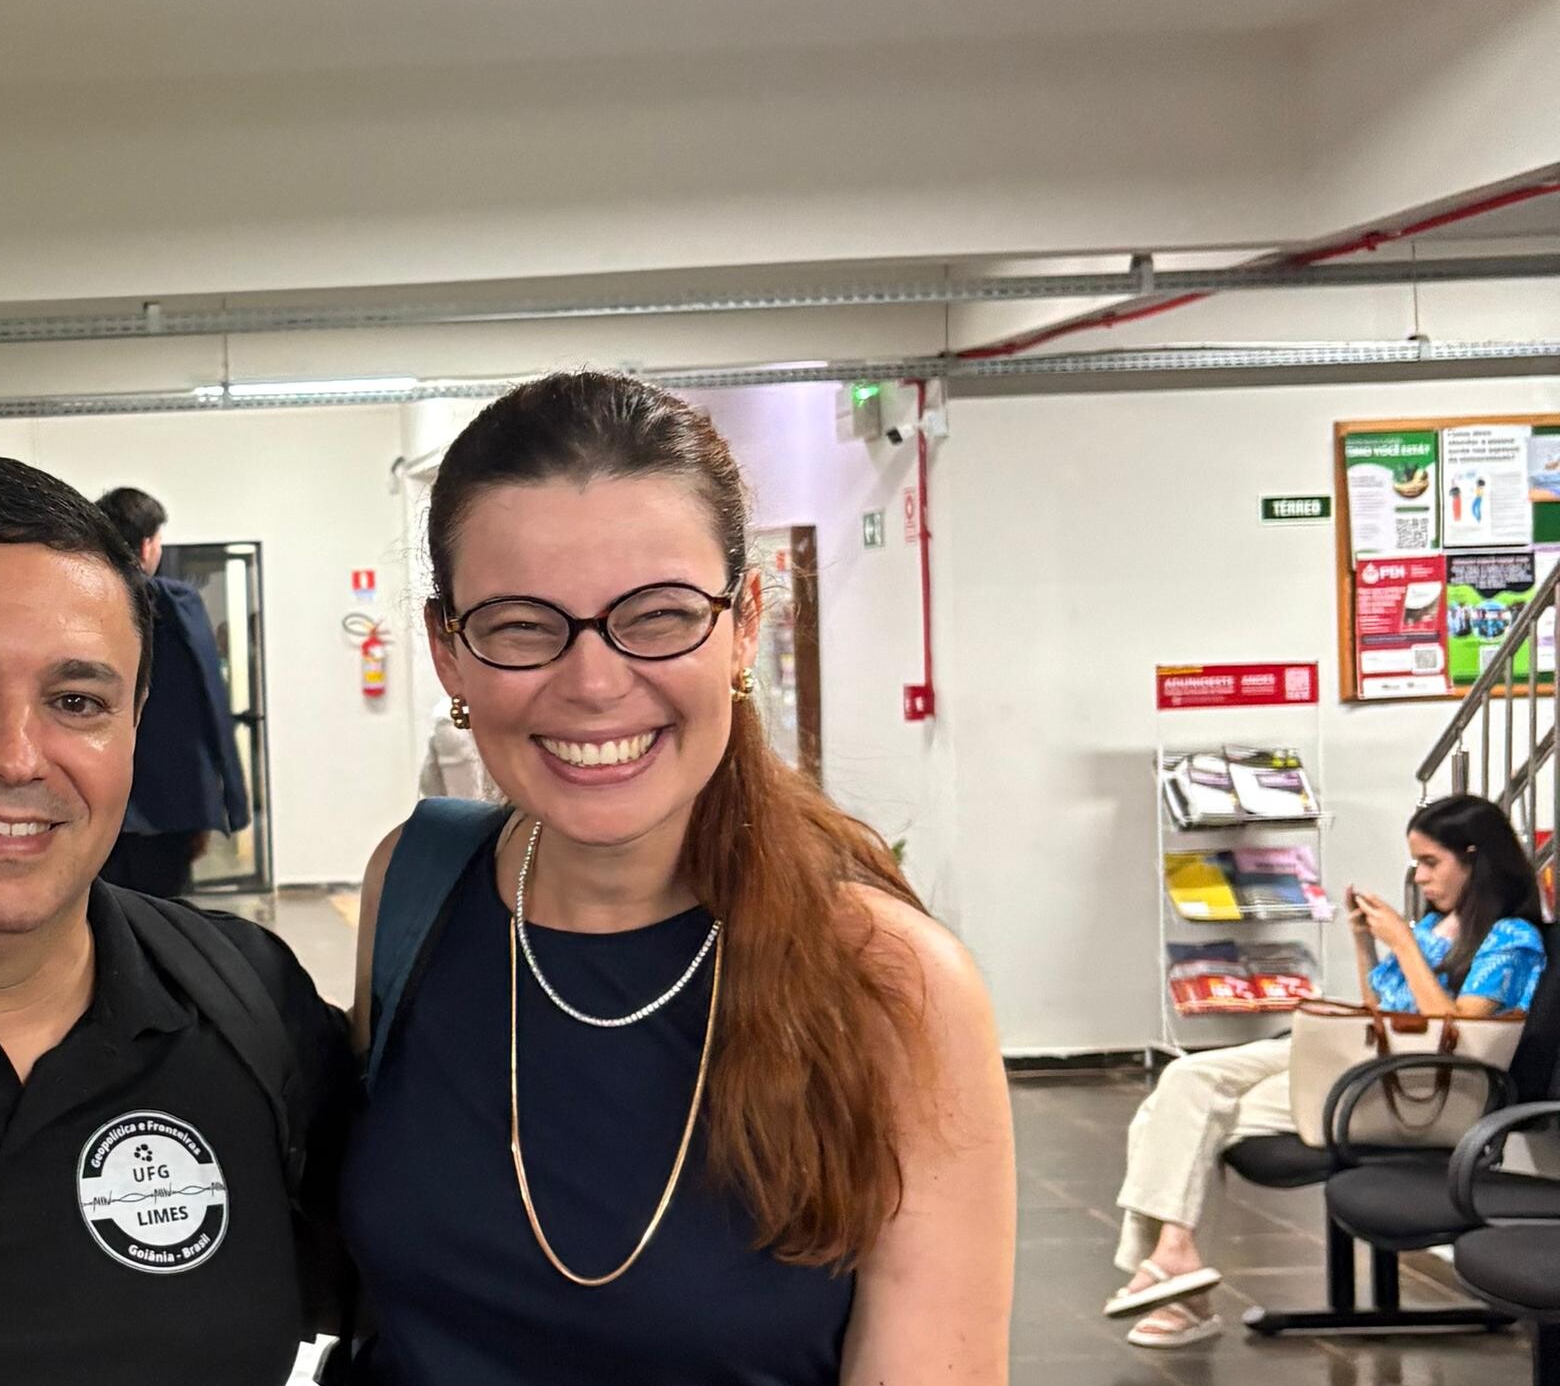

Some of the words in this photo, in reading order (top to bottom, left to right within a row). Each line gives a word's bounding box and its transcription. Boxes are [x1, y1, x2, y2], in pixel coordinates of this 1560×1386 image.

[1272, 498, 1321, 517] TÉRREO
[91, 1123, 137, 1168] Geopolítica
[138, 1122, 146, 1131] e
[147, 1120, 201, 1156] Fronteiras
[133, 1164, 170, 1183] UFG
[137, 1205, 189, 1226] LIMES
[128, 1244, 175, 1263] Goiânia
[181, 1233, 211, 1259] Brasil
